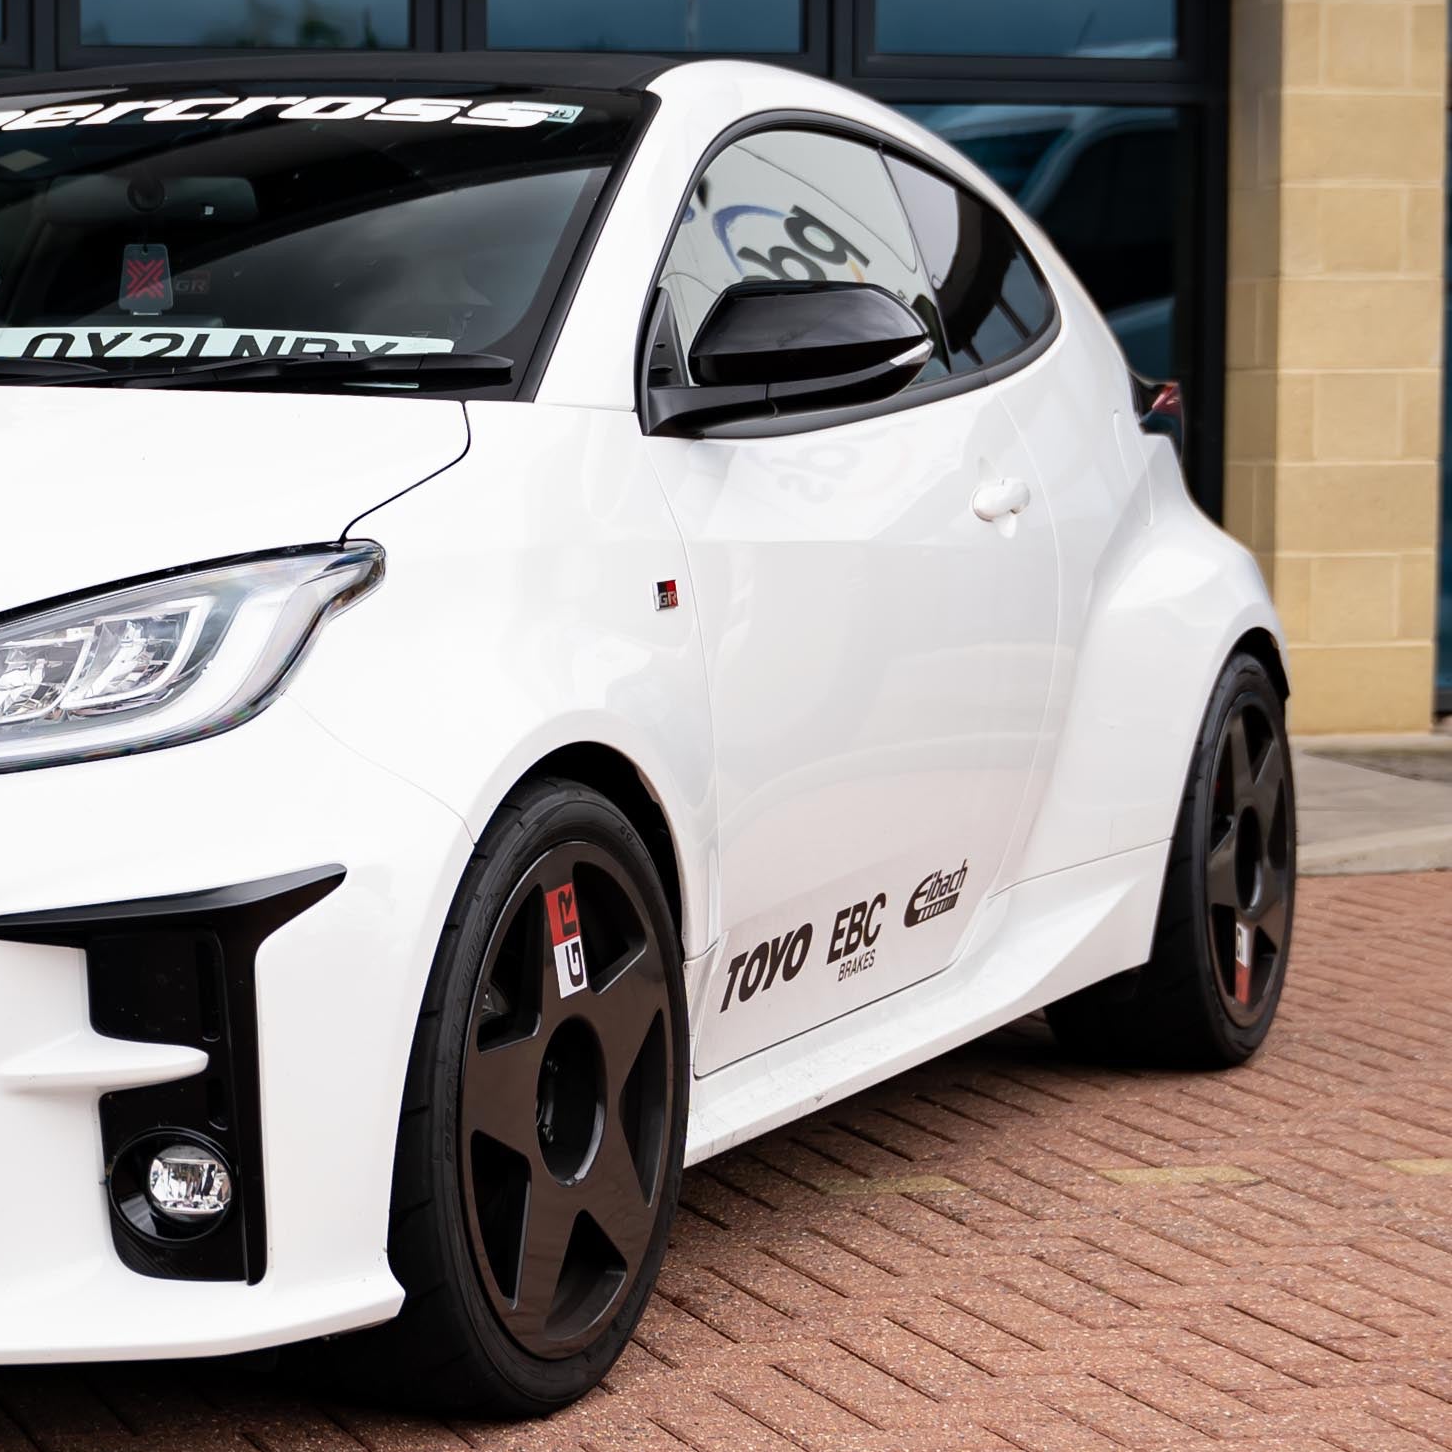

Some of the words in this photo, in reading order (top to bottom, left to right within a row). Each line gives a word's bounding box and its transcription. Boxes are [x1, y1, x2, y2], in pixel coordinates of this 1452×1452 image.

[659, 591, 678, 607] GR
[904, 858, 968, 928] Eibach
[557, 889, 585, 988] GR
[719, 922, 813, 1014] TOYO
[827, 893, 886, 965] EBC
[838, 948, 876, 982] BRAKES
